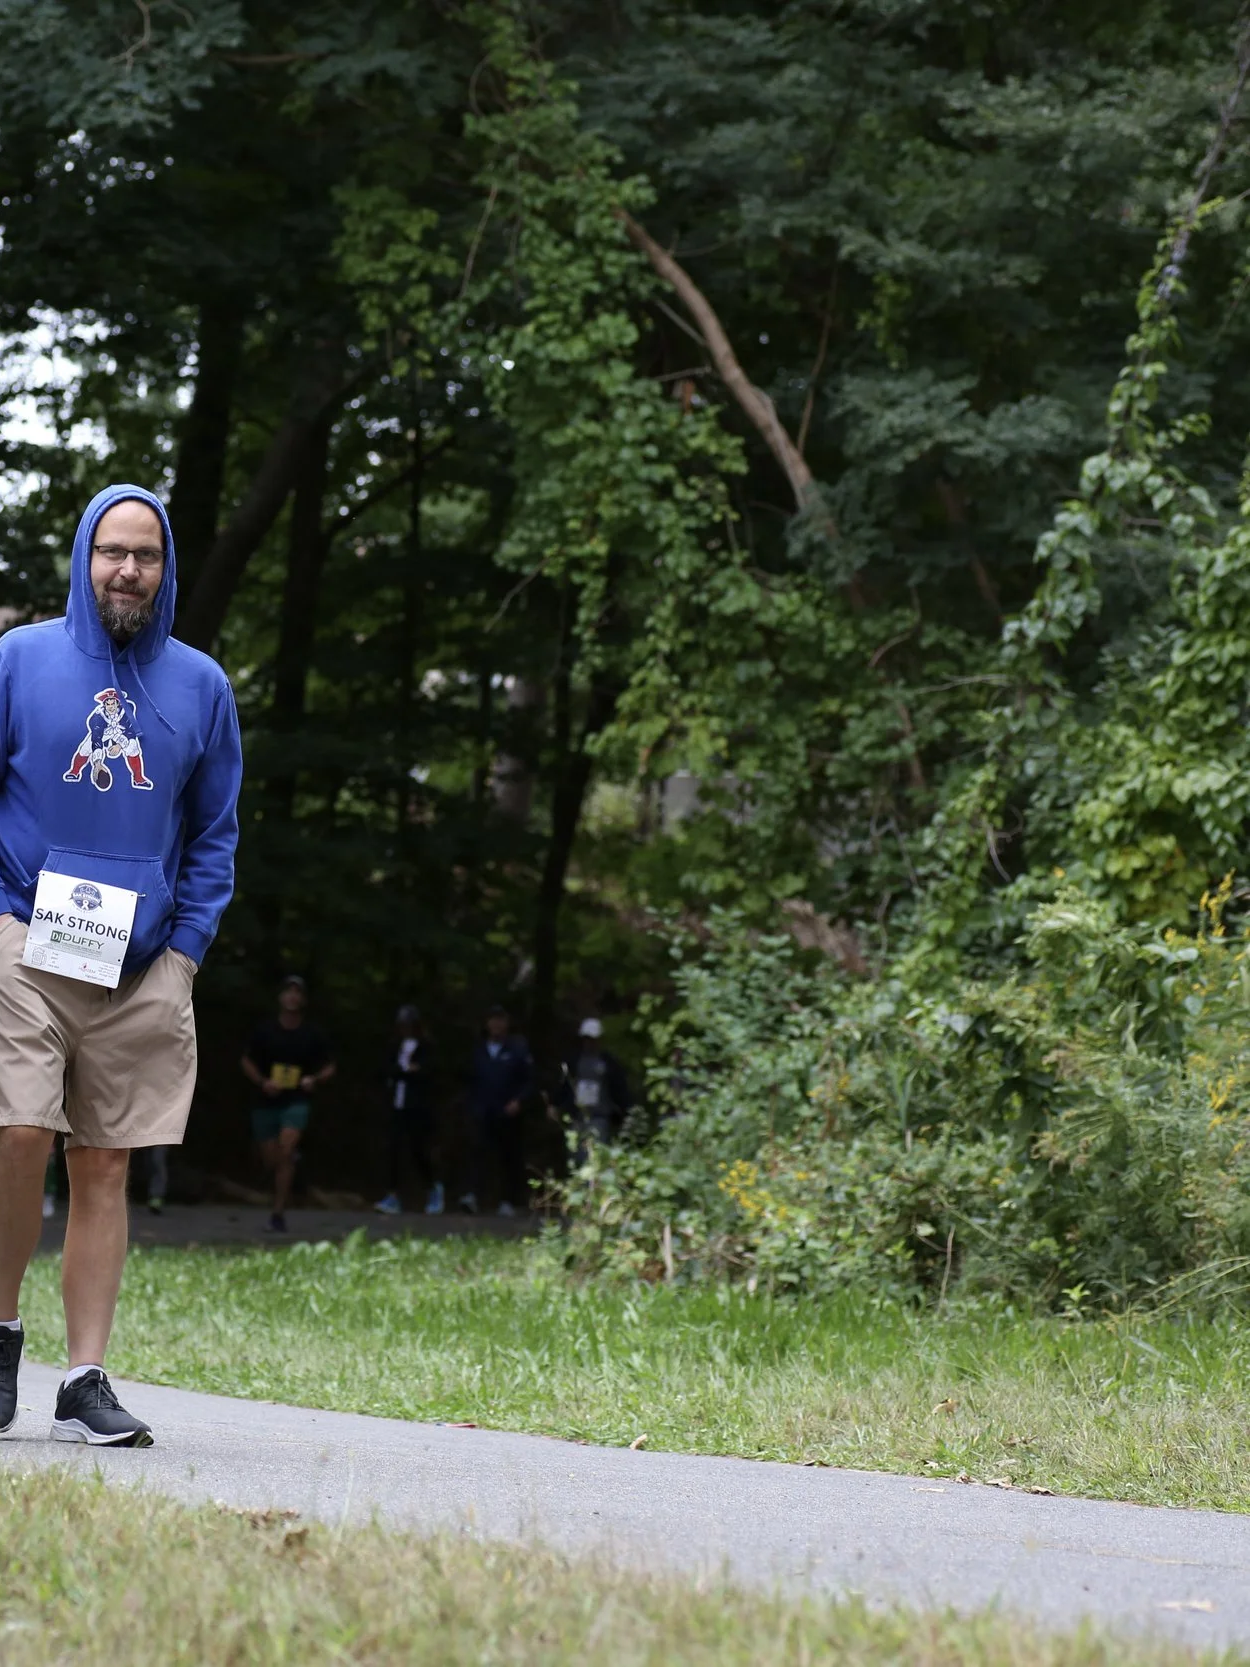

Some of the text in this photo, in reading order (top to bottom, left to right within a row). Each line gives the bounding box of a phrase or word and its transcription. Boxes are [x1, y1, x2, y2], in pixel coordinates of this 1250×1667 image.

[34, 908, 128, 942] SAK STRONG
[62, 932, 105, 950] DUFFY
